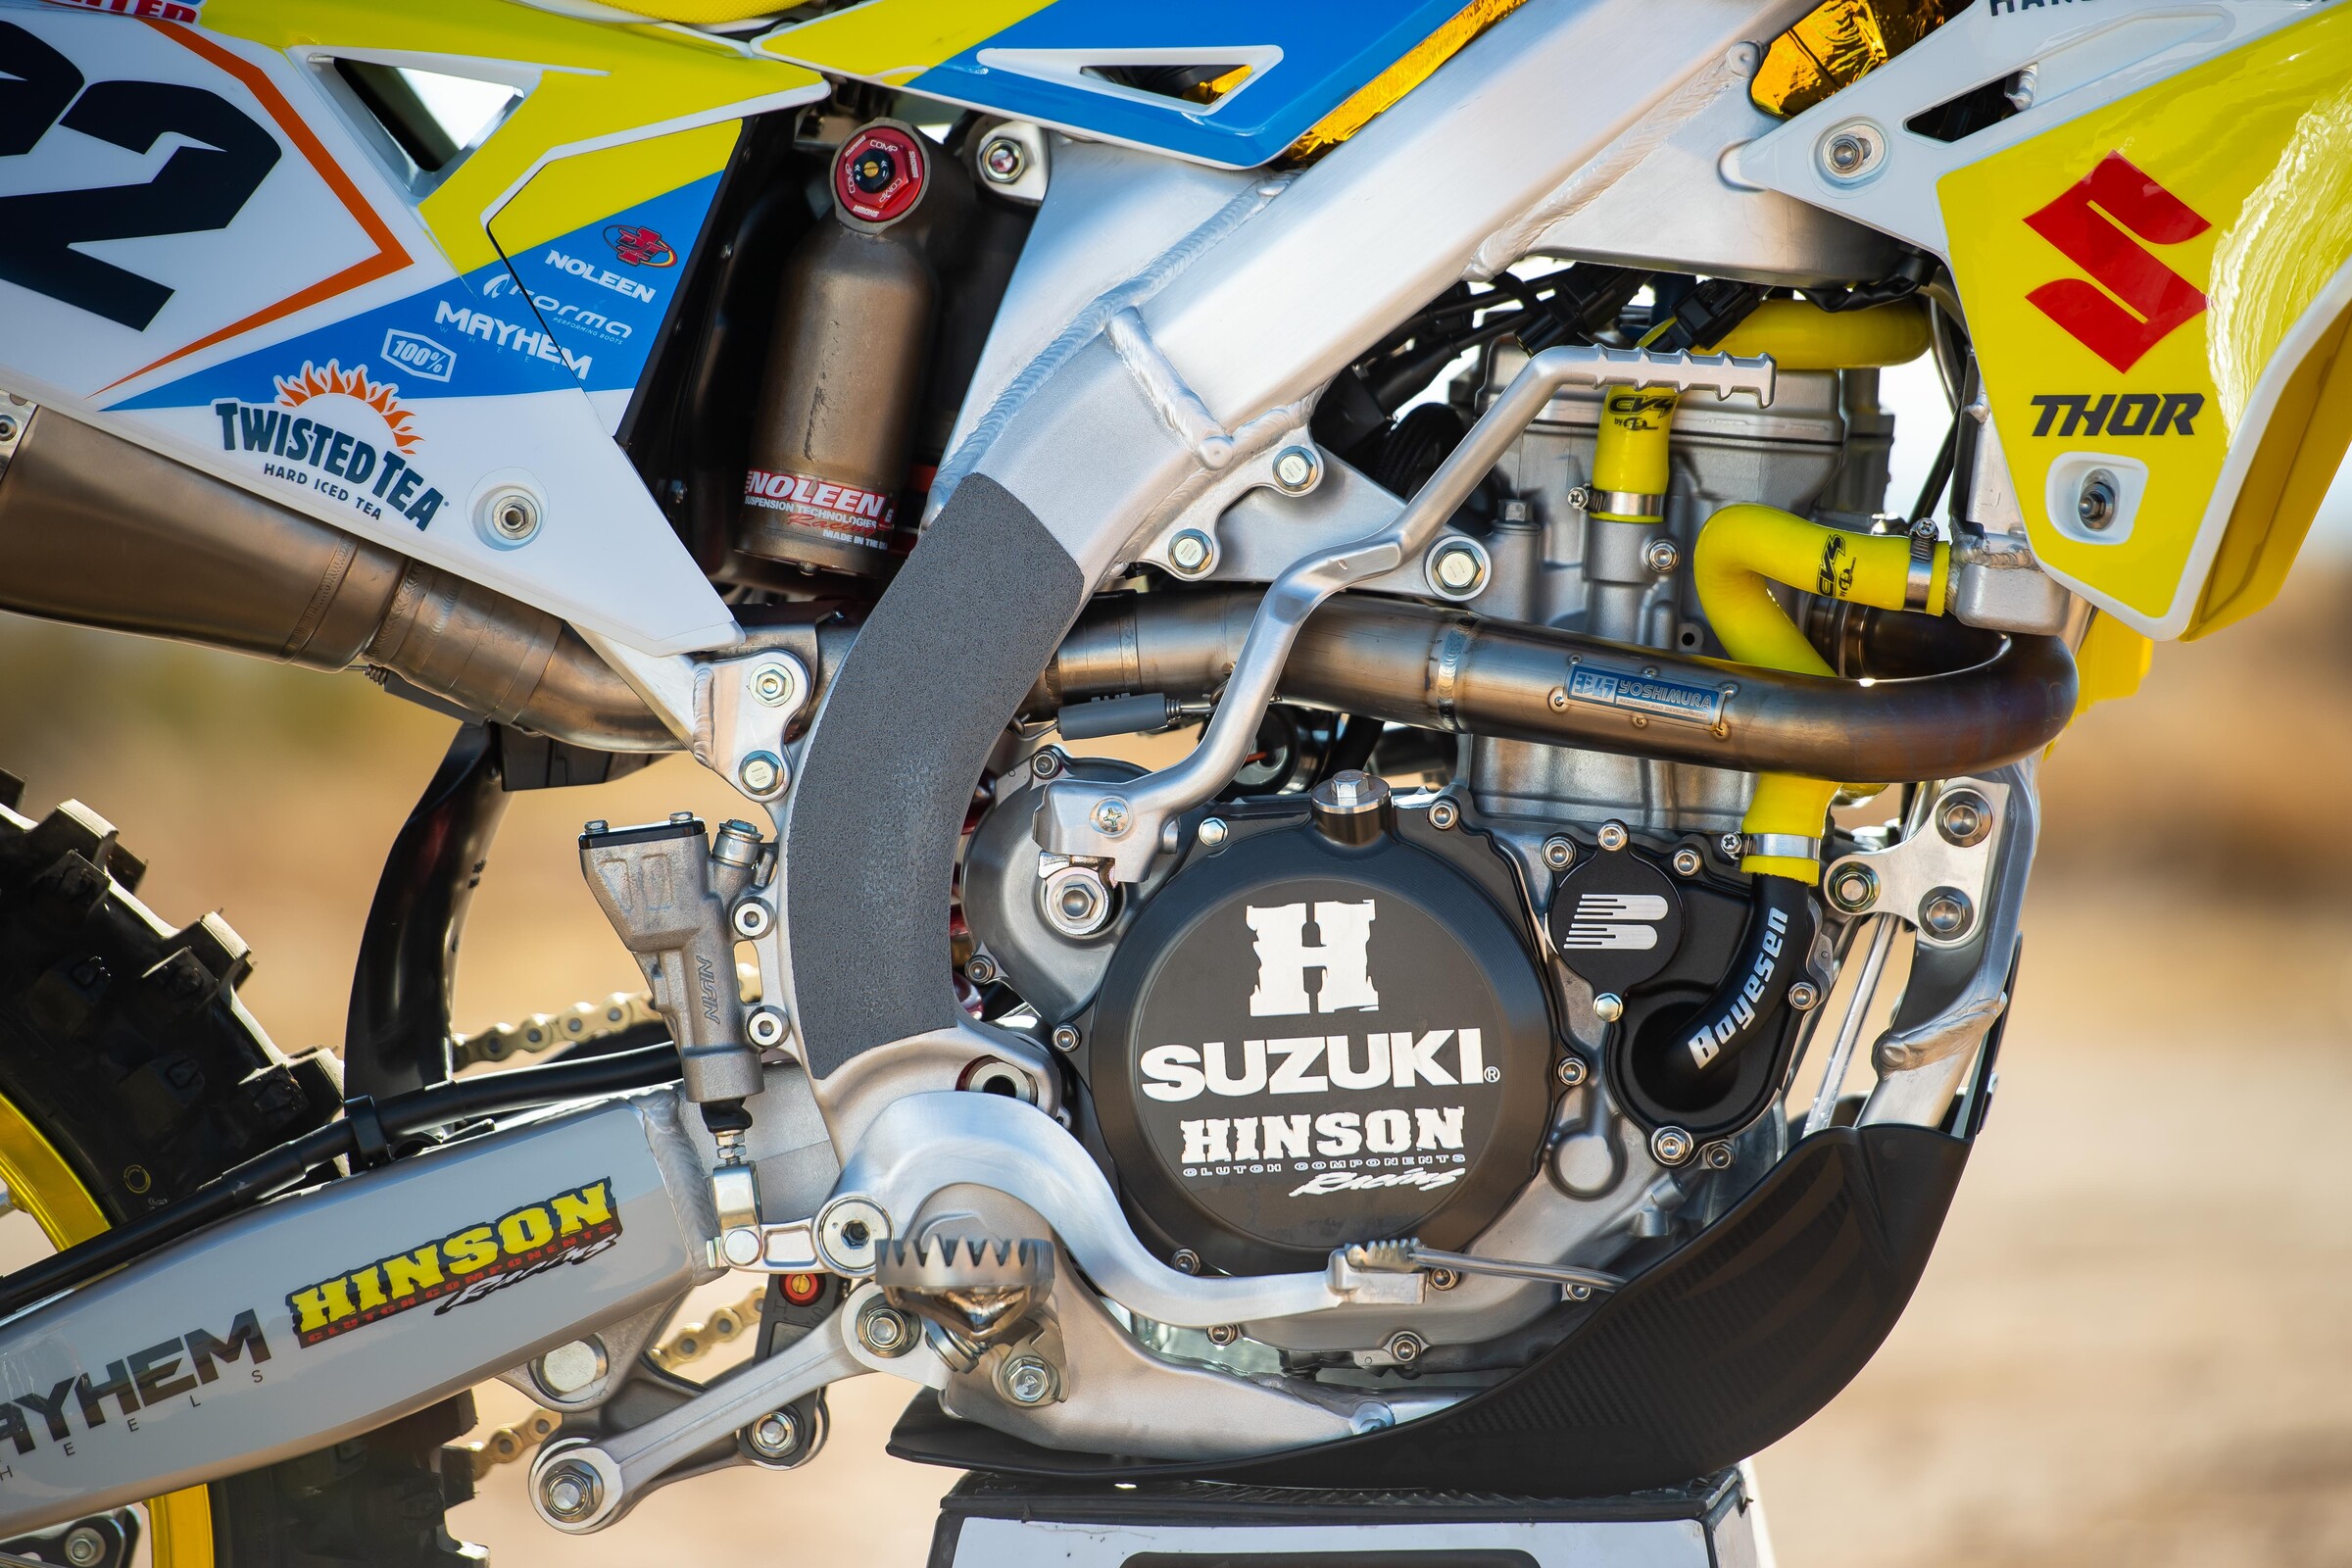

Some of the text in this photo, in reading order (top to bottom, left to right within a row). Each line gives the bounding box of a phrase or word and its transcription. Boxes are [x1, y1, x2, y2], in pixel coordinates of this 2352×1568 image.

[869, 139, 899, 153] COMP
[545, 249, 657, 304] NOLEEN
[392, 339, 444, 373] 100%
[434, 300, 593, 380] MAYHEM
[2030, 393, 2205, 436] THOR
[216, 402, 377, 484] TWISTED
[263, 463, 382, 521] HARD ICED TEA
[749, 470, 886, 518] NOLEEN
[822, 529, 853, 542] MADE
[854, 535, 864, 545] IN
[1618, 679, 1712, 710] YOSHIMURA
[1246, 899, 1379, 1017] H
[1688, 906, 1788, 1069] Boyesen
[1180, 1106, 1465, 1164] HINSON
[1183, 1153, 1466, 1178] CLUTCH COMPONENTS
[292, 1180, 613, 1334] HINSON
[307, 1222, 613, 1344] CLUTCH COMPONENTS
